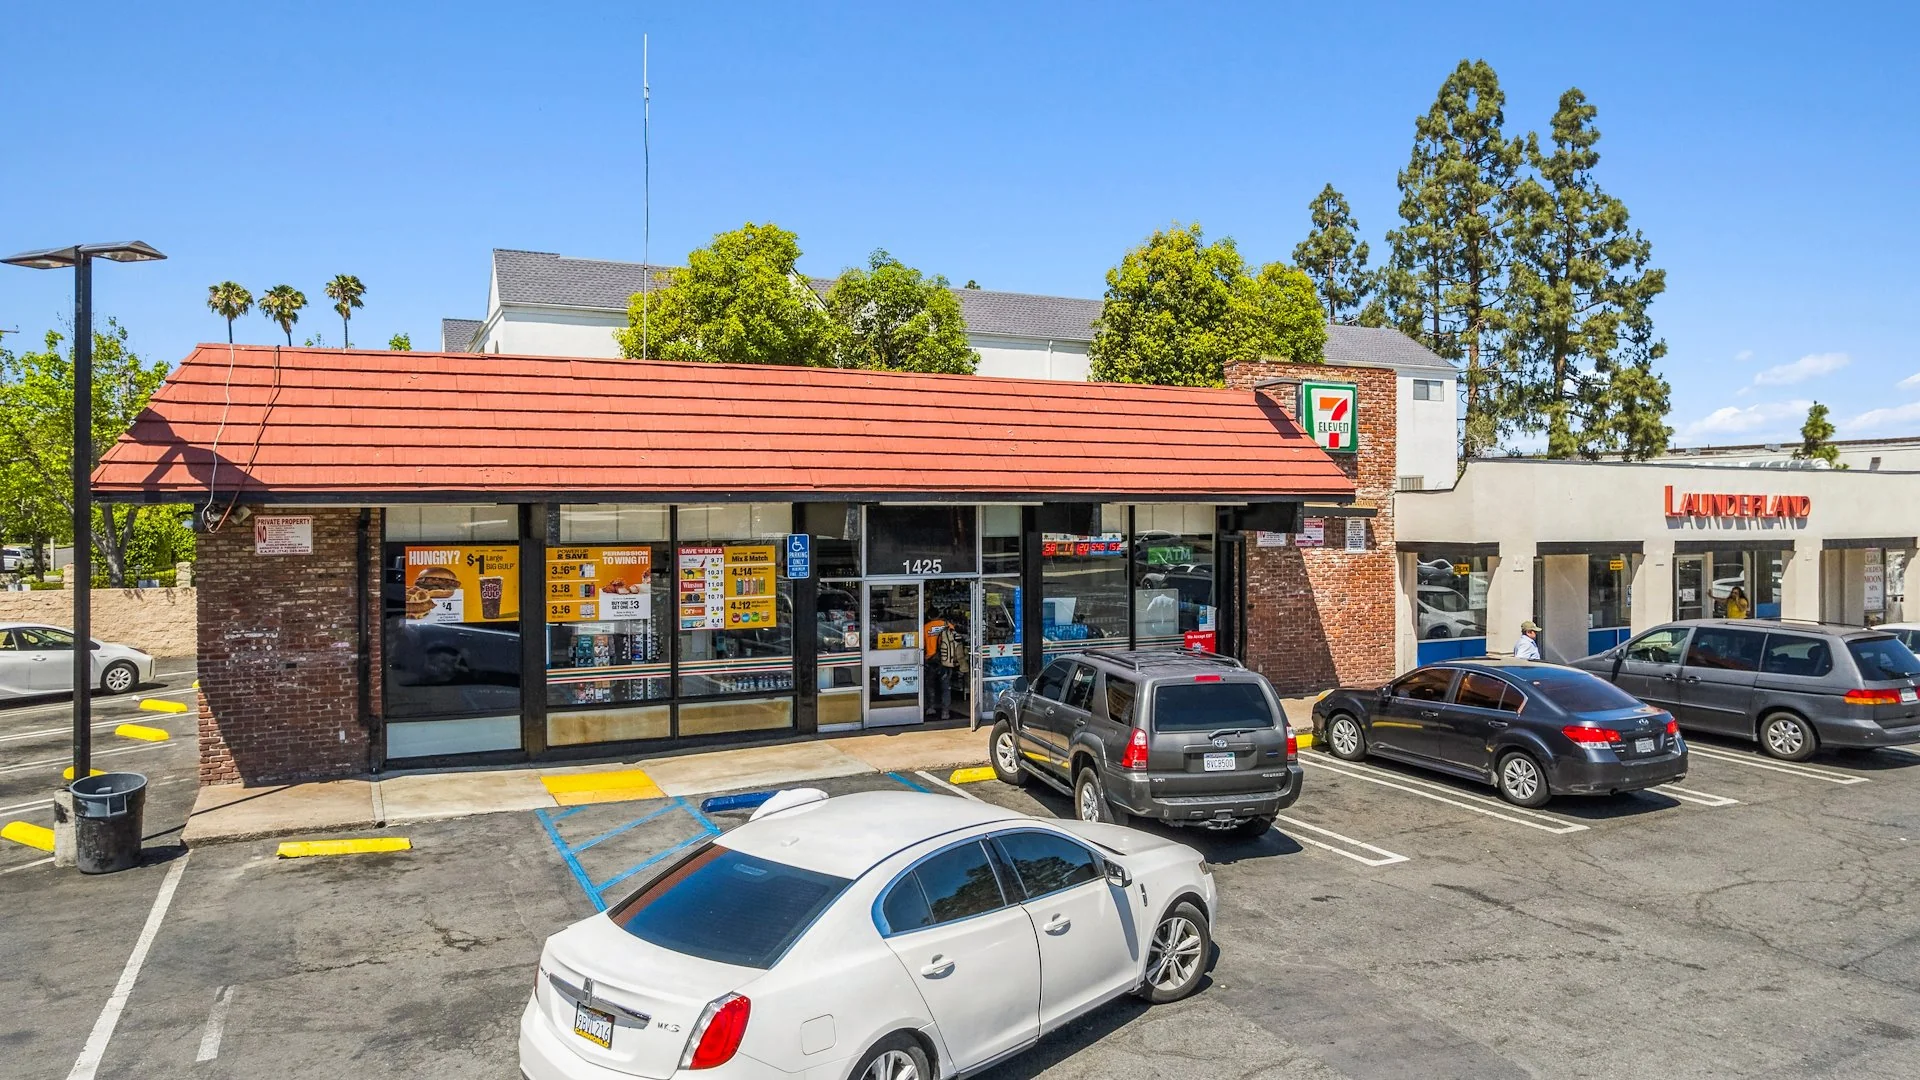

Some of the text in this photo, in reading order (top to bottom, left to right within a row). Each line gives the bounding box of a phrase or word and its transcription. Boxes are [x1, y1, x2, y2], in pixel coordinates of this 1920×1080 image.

[1319, 396, 1348, 448] 7
[257, 525, 267, 544] NO
[409, 550, 460, 566] HUNGRY?
[1166, 549, 1190, 560] ATM
[467, 554, 484, 574] $1
[903, 559, 942, 574] 1425
[552, 584, 557, 593] 3
[561, 584, 570, 592] $8
[442, 602, 452, 612] $4
[552, 606, 557, 614] 3
[561, 605, 570, 614] $6
[631, 600, 639, 609] $3
